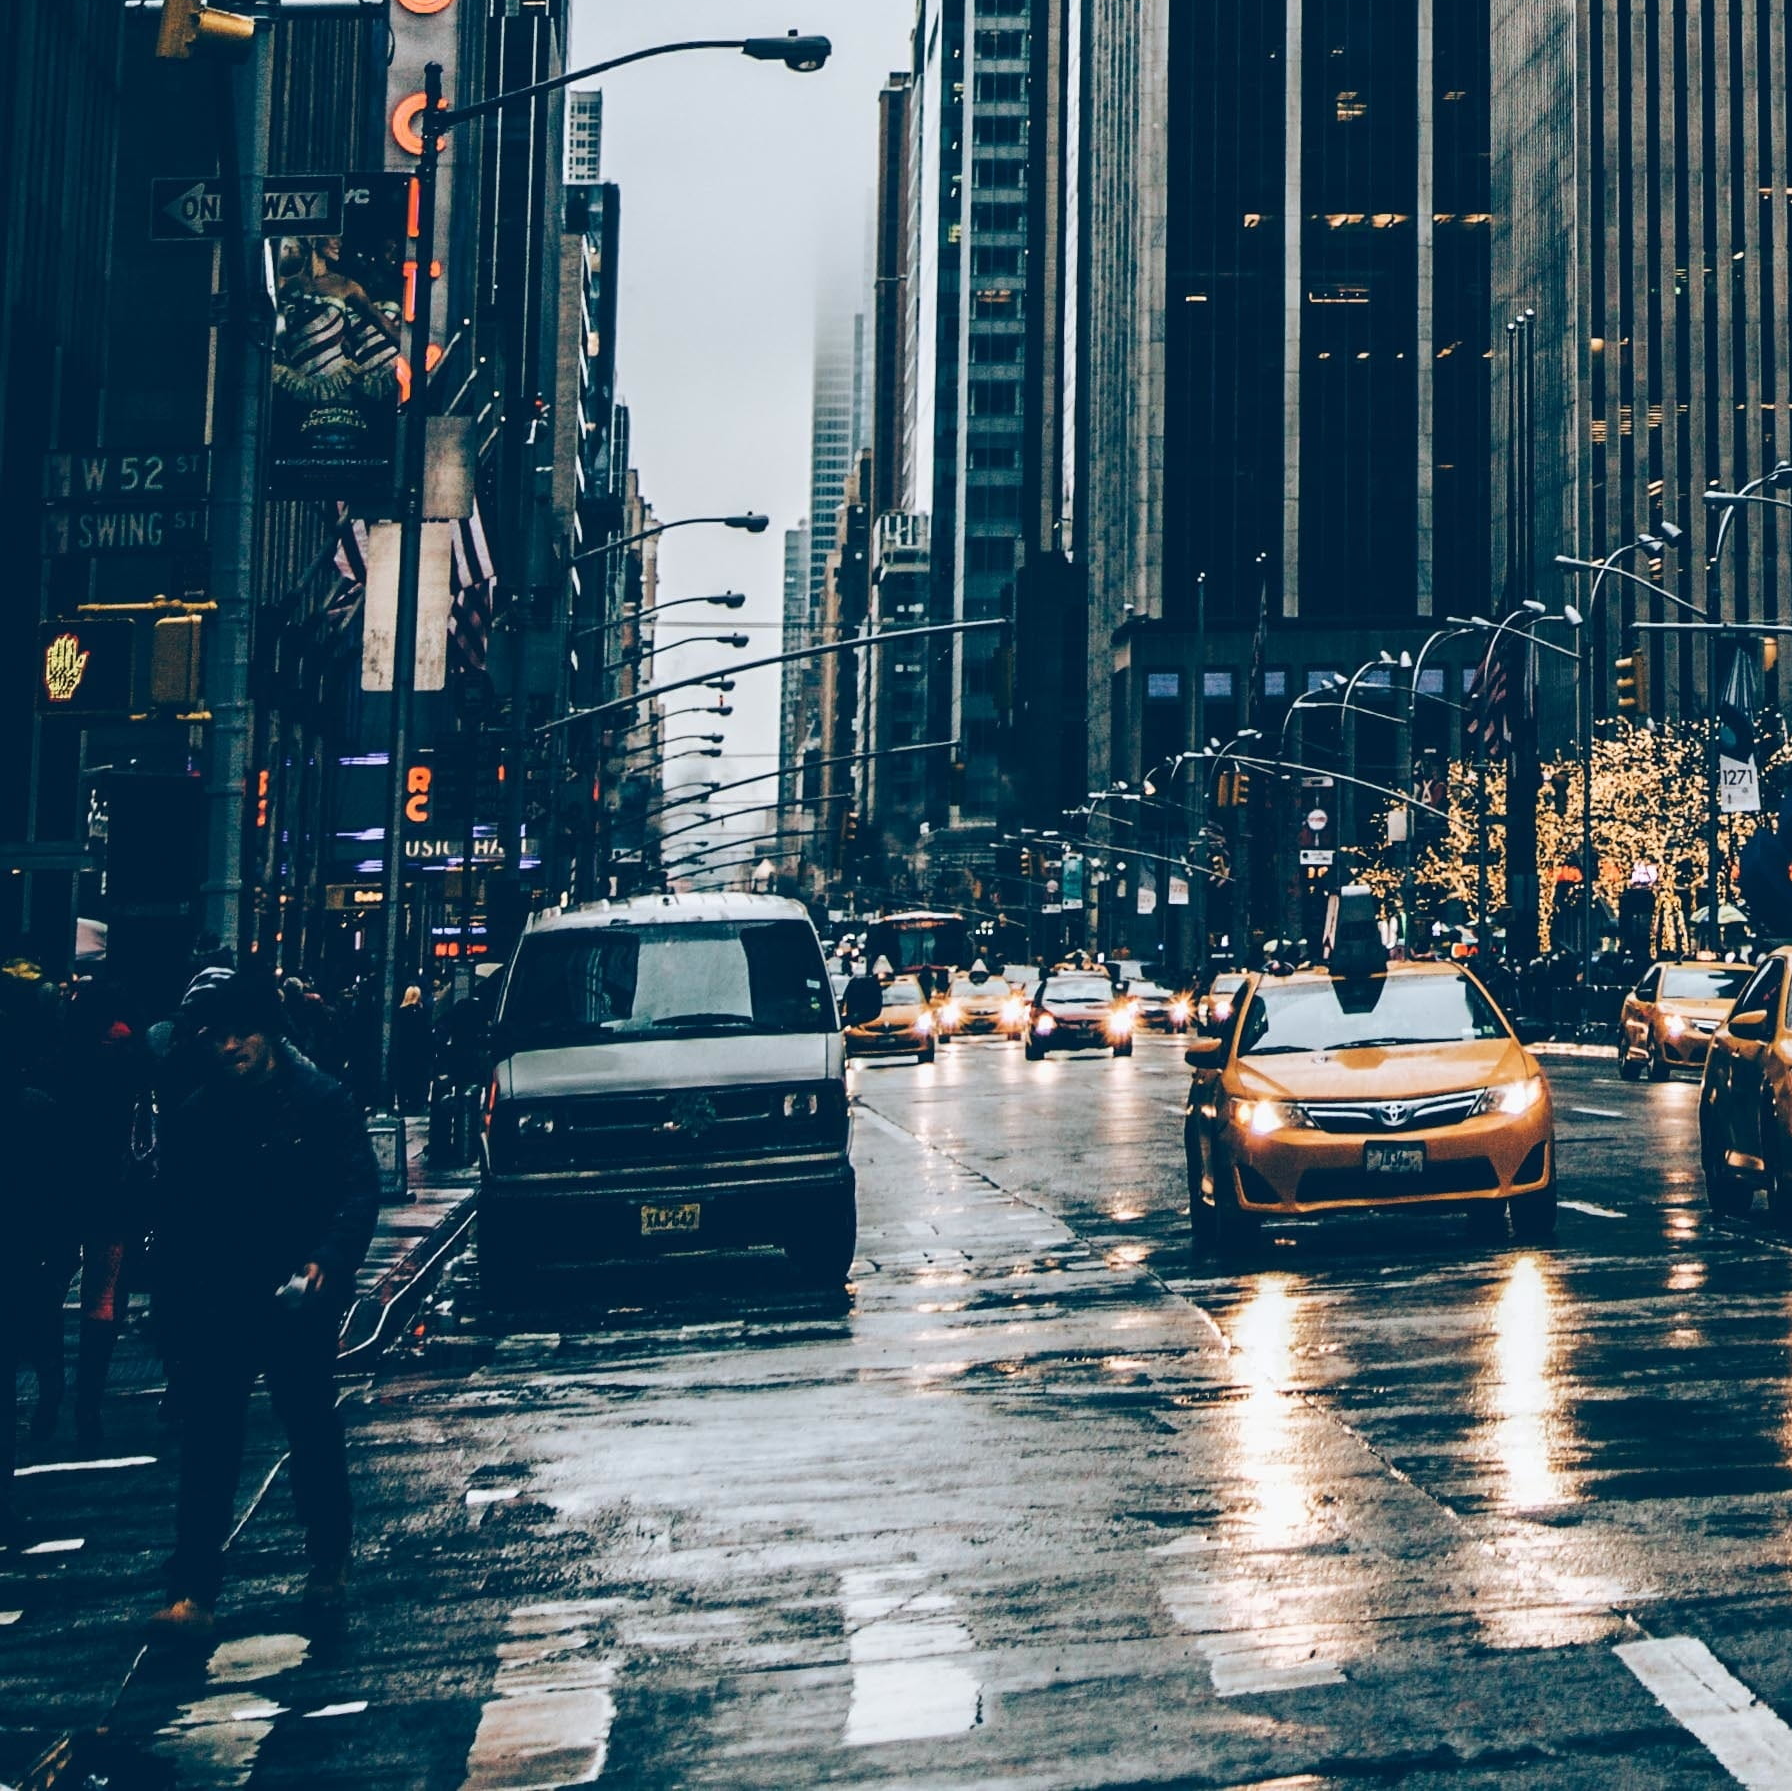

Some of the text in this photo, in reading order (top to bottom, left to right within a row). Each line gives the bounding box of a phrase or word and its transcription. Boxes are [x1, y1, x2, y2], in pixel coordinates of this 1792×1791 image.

[182, 192, 317, 218] ON WAY
[82, 454, 200, 492] W 52 ST
[79, 510, 201, 549] SWING ST
[1722, 769, 1754, 786] 1271
